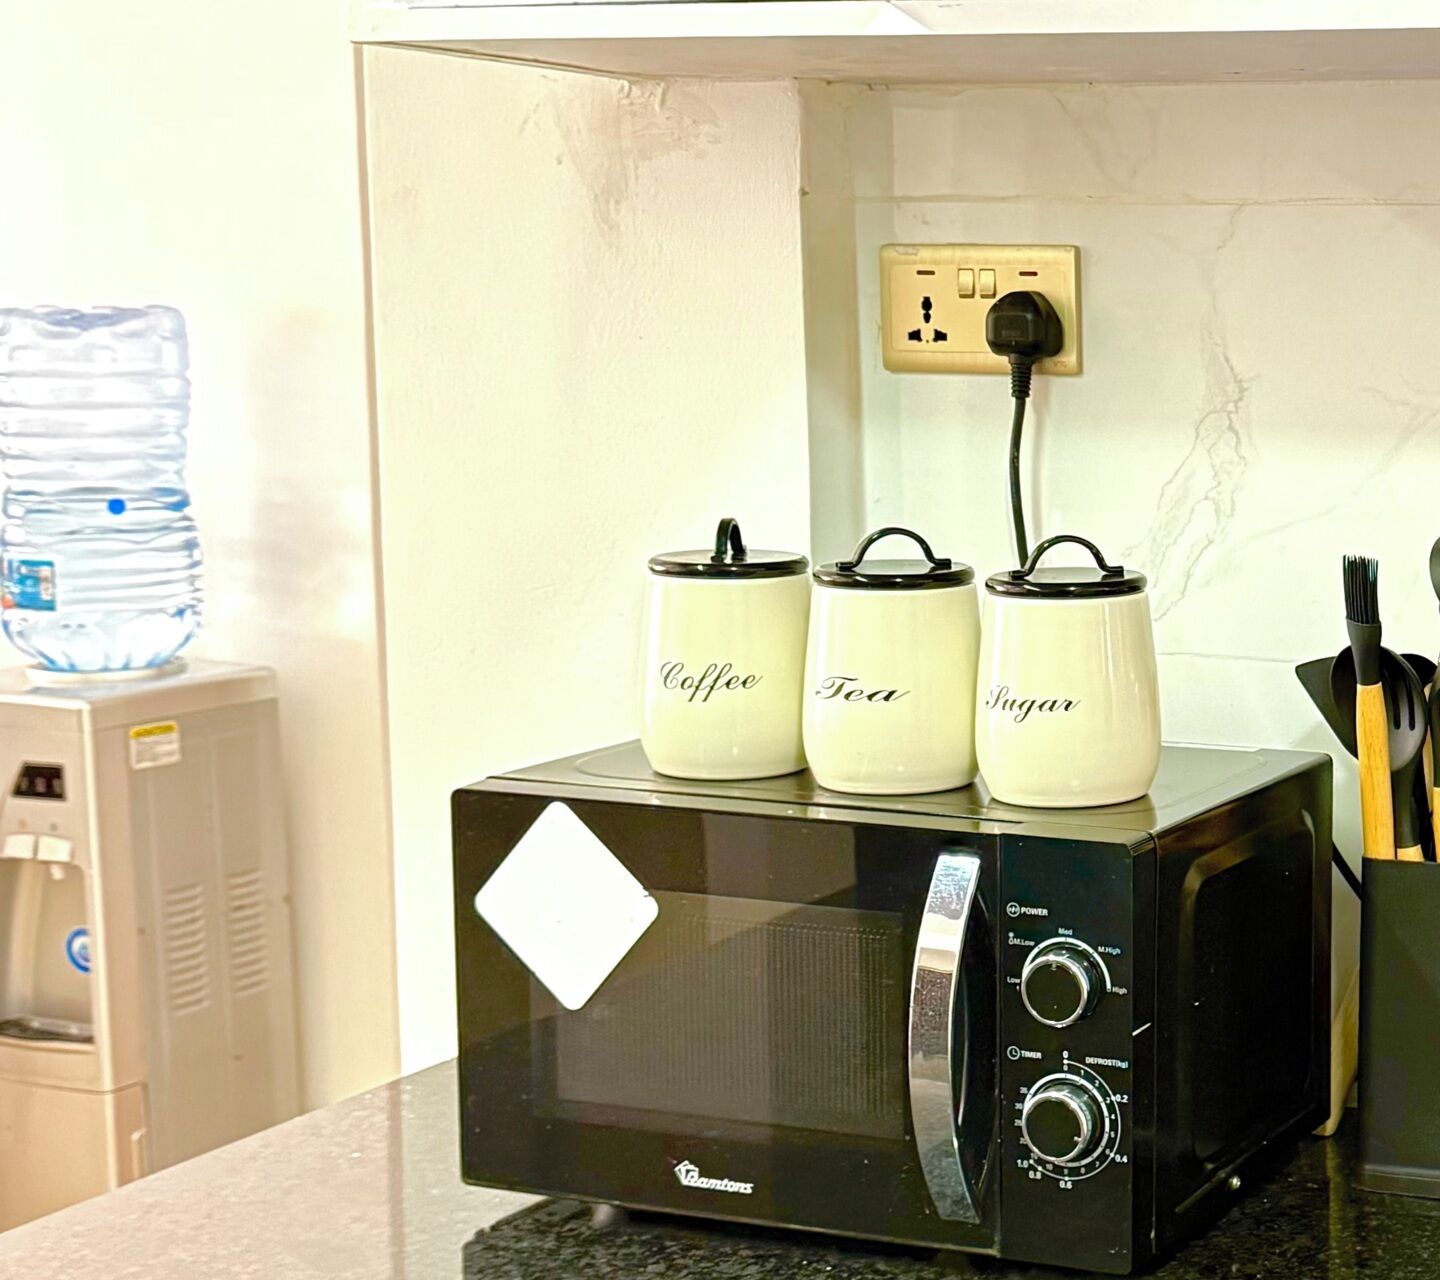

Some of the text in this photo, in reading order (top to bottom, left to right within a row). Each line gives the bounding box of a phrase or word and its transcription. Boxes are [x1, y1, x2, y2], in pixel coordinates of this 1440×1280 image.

[660, 661, 764, 702] Coffee
[815, 676, 911, 702] Tea
[985, 684, 1081, 723] Sugar
[1021, 907, 1048, 916] POWER
[1058, 927, 1073, 935] Med
[1112, 986, 1127, 995] High
[1021, 1050, 1042, 1059] TIMER
[1062, 1050, 1069, 1058] 0
[1115, 1094, 1128, 1103] 0.2
[1115, 1154, 1128, 1163] 0.4
[1017, 1159, 1028, 1168] 1.0
[1028, 1171, 1041, 1180] 0.8
[1059, 1180, 1072, 1189] 0.6
